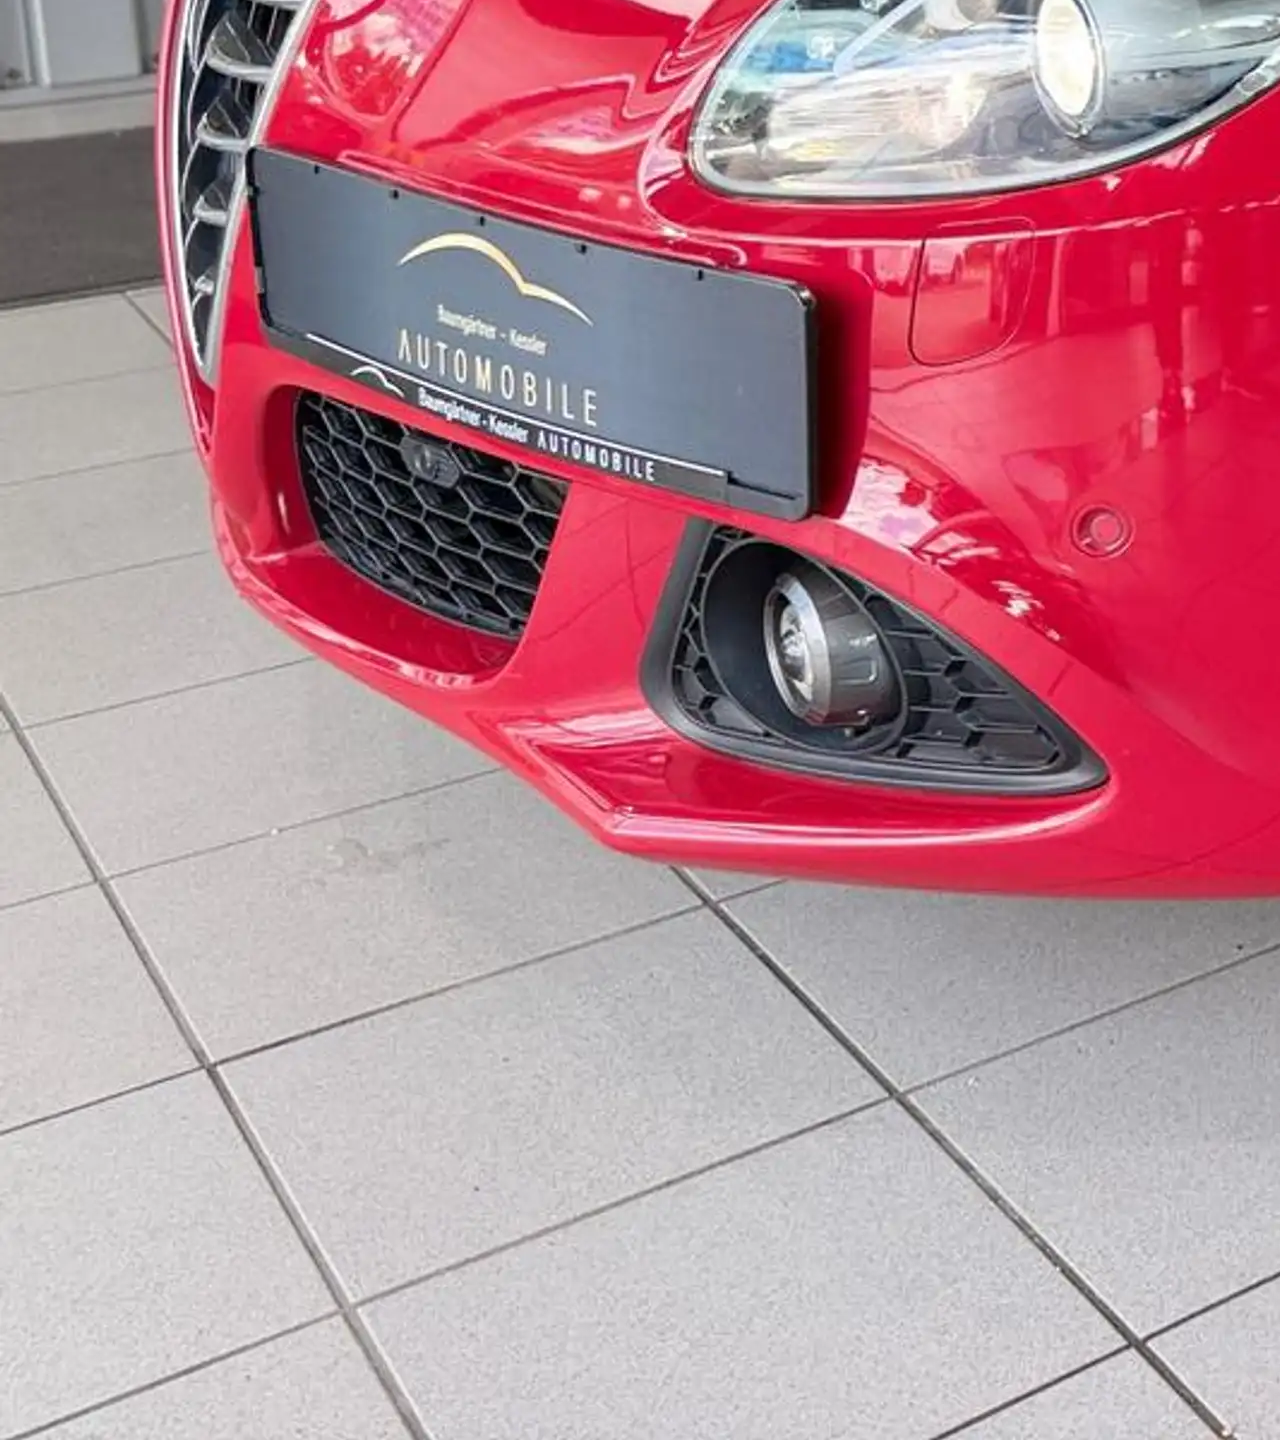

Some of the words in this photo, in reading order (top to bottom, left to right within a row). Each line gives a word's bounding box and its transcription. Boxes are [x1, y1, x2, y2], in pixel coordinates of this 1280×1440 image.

[509, 327, 547, 357] Kessler
[398, 328, 597, 427] AUTOMOBILE
[489, 412, 529, 443] Kessler
[537, 429, 655, 481] AUTOMOBILE
